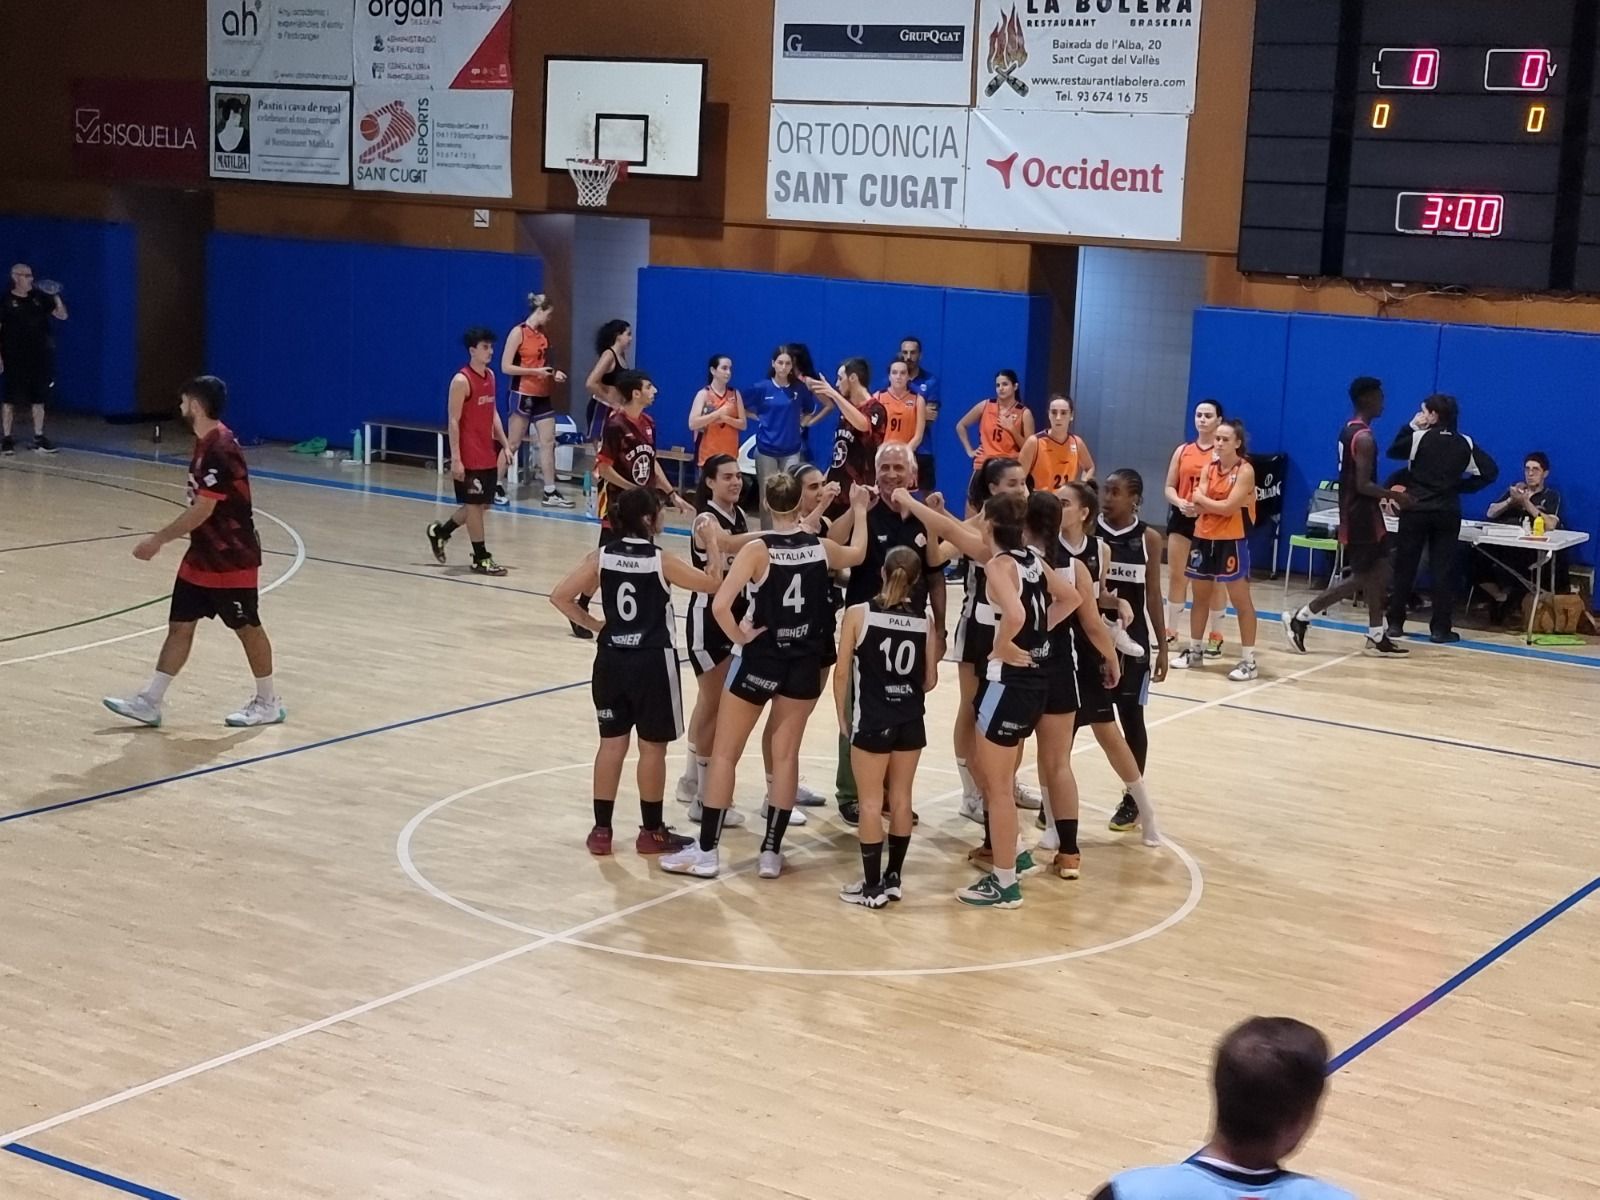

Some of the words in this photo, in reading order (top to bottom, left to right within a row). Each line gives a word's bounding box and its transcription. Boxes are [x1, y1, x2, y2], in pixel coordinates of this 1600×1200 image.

[1027, 0, 1060, 14] LA
[1076, 0, 1193, 14] BOLERA
[1027, 19, 1097, 28] RESTAURANT
[1130, 19, 1193, 28] BRASERIA
[1052, 39, 1092, 50] Baixada
[1095, 39, 1109, 51] de
[1112, 39, 1143, 52] l'Alba,
[1148, 40, 1162, 51] 20
[1052, 55, 1074, 65] Sant
[1078, 55, 1108, 67] Cugat
[1112, 55, 1127, 65] del
[1130, 55, 1160, 66] Vallès
[1412, 54, 1435, 86] 0
[1522, 54, 1545, 87] 0
[1546, 64, 1558, 78] V
[1031, 75, 1186, 88] www.restaurantlabolera.com
[1056, 91, 1074, 102] Tel.
[1077, 91, 1090, 102] 93
[1092, 92, 1113, 102] 674
[1117, 92, 1131, 102] 16
[1134, 92, 1149, 103] 75
[307, 102, 318, 113] de
[319, 103, 341, 115] regal
[1372, 104, 1390, 129] 0
[1526, 106, 1546, 132] 0
[103, 123, 197, 149] SISQUELLA
[417, 98, 430, 165] ESPORTS
[776, 121, 959, 159] ORTODONCIA
[357, 165, 387, 181] SANT
[389, 166, 429, 185] CUGAT
[1022, 157, 1164, 194] Occident
[774, 169, 849, 205] SANT
[859, 173, 959, 210] CUGAT
[1421, 196, 1500, 231] 3:00
[890, 418, 902, 433] 91
[992, 428, 1003, 443] 15
[616, 559, 640, 569] ANNA
[806, 549, 817, 560] V.
[1225, 556, 1236, 574] 9
[616, 581, 638, 622] 6
[782, 573, 805, 614] 4
[879, 637, 916, 675] 10
